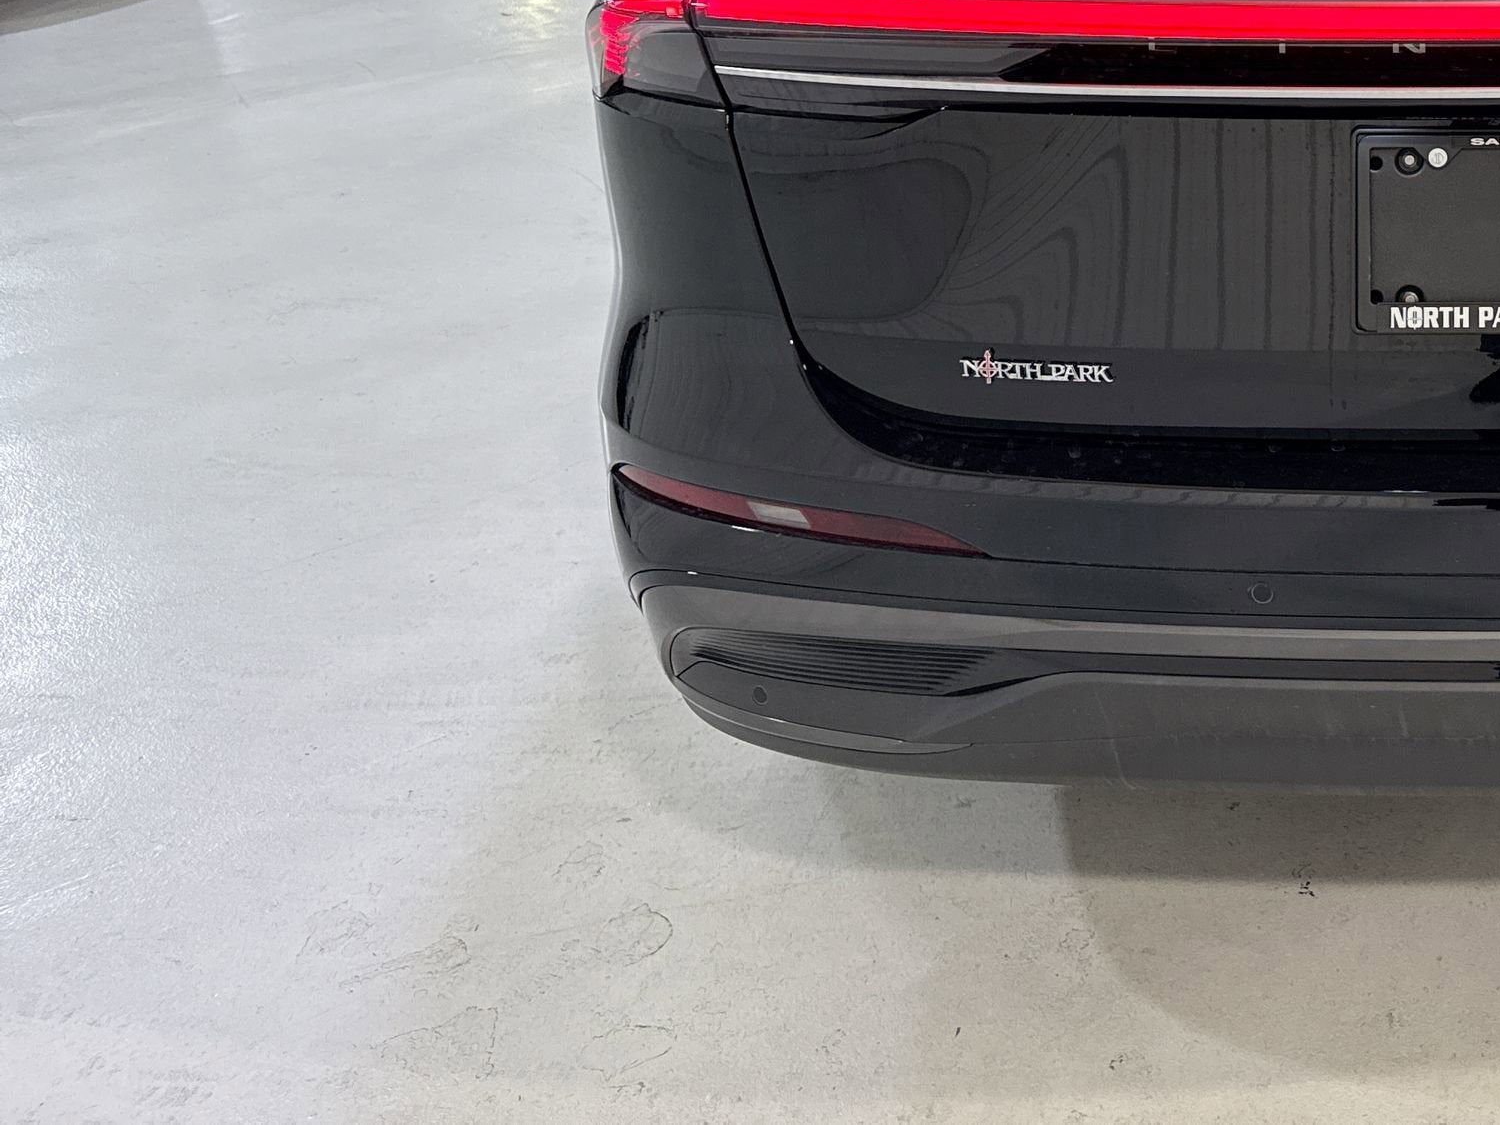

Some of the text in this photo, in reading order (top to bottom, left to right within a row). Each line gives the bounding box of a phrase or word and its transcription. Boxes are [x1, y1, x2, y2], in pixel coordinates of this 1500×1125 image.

[1390, 306, 1470, 329] NORTH
[959, 351, 1114, 383] NORTH PARK
